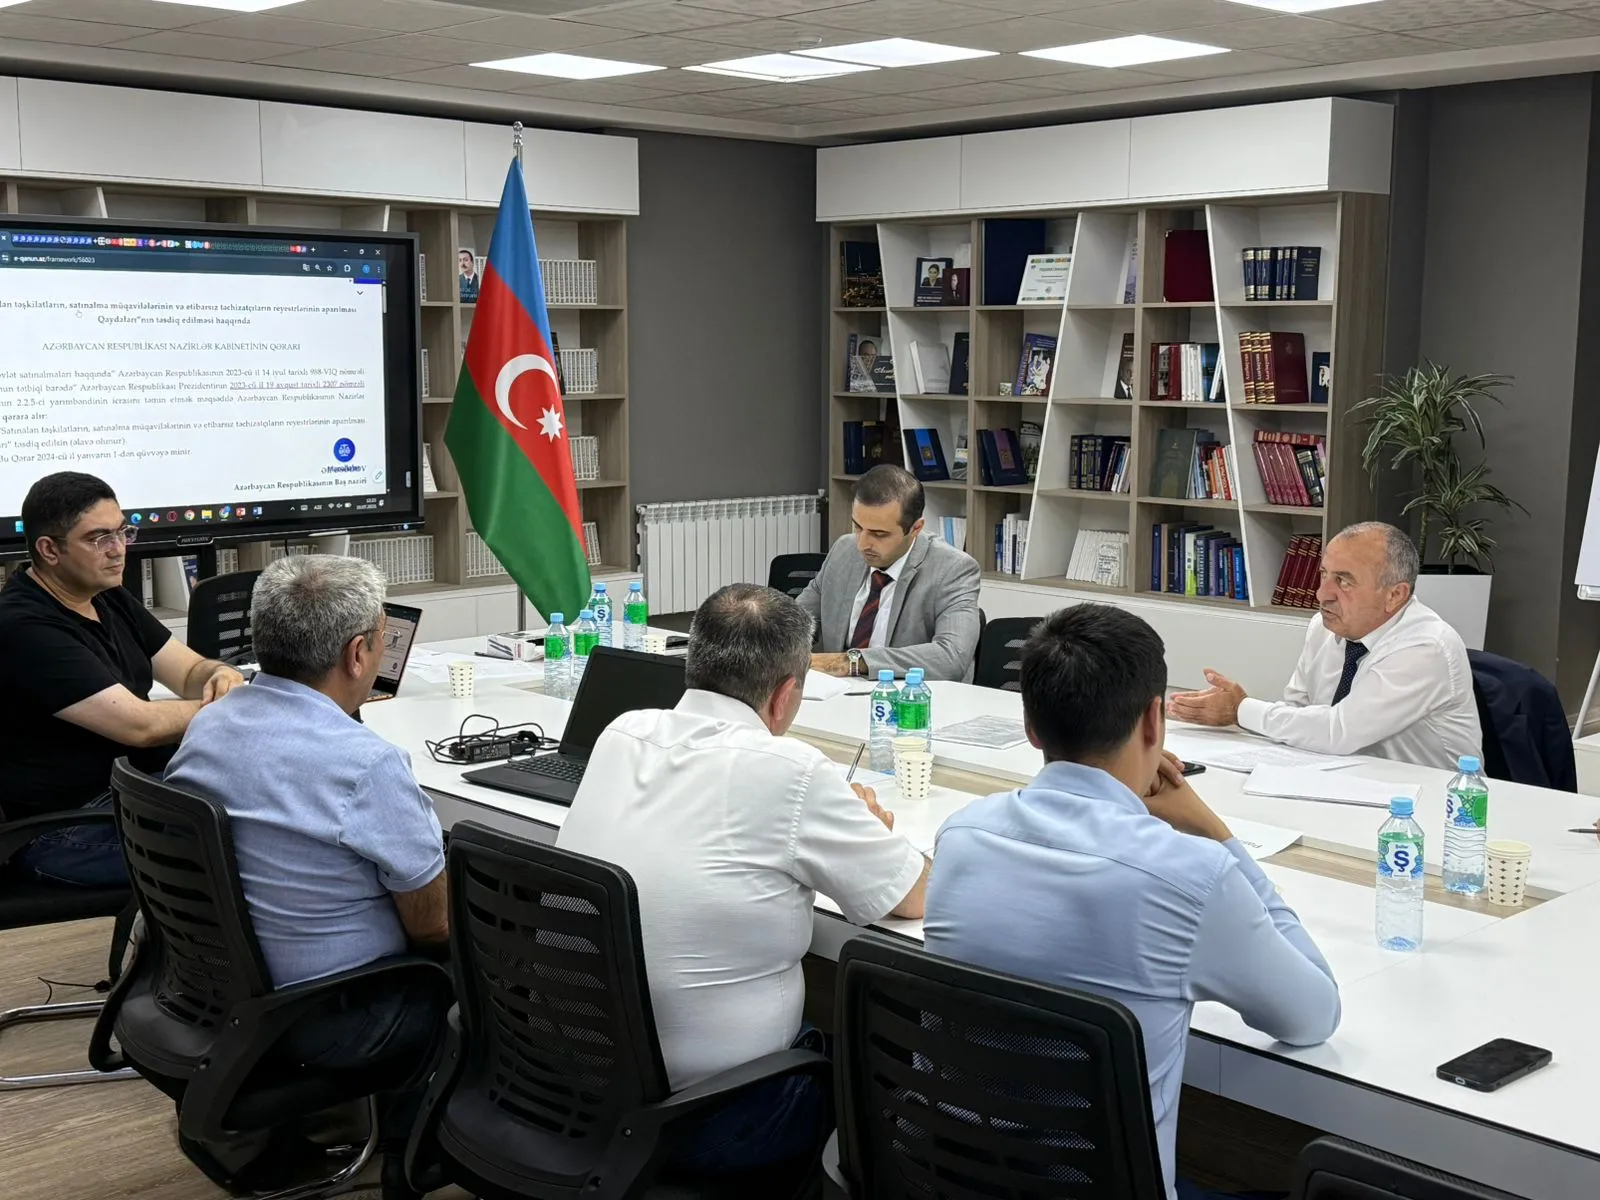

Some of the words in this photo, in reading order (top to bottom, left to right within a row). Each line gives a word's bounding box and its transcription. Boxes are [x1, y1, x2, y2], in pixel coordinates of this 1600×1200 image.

[15, 300, 67, 310] təşkilatların,
[69, 301, 108, 309] satınalma
[110, 302, 173, 312] müqavilələrinin
[187, 303, 218, 311] etibarsız
[220, 303, 271, 313] təchizatçıların
[273, 304, 320, 315] reyestrlərinin
[322, 306, 357, 315] aparılması
[156, 316, 180, 326] təsdiq
[182, 316, 214, 325] edilməsi
[215, 317, 251, 327] haqqında
[42, 342, 105, 351] AZƏRBAYCAN
[107, 341, 167, 351] RESPUBLİKASI
[169, 341, 213, 351] NAZİRLƏR
[214, 341, 268, 351] KABİNETİNİN
[269, 343, 301, 352] QƏRARI
[19, 370, 72, 379] satınalmaları
[118, 369, 163, 380] Azərbaycan
[165, 368, 224, 380] Respublikasının
[255, 368, 260, 376] il
[272, 368, 286, 378] iyul
[16, 384, 43, 395] tətbiqi
[80, 383, 126, 395] Azərbaycan
[128, 382, 176, 393] Respublikası
[179, 381, 228, 391] Prezidentinin
[259, 380, 264, 389] il
[266, 381, 274, 389] 19
[17, 398, 45, 407] 2.2.5-ci
[49, 397, 108, 409] yarımbəndinin
[112, 396, 140, 405] icrasını
[169, 396, 193, 404] etmək
[237, 394, 278, 404] Azərbaycan
[282, 393, 335, 404] Respublikasının
[2, 413, 29, 424] qərara
[93, 422, 130, 433] satınalma
[132, 421, 191, 434] müqavilələrinin
[203, 419, 233, 429] etibarsız
[14, 438, 39, 450] təsdiq
[70, 436, 94, 448] (əlavə
[11, 454, 35, 464] Qərar
[37, 453, 67, 461] 2024-cü
[69, 452, 75, 460] il
[77, 451, 111, 464] yanvarın
[136, 449, 169, 461] qüvvəyə
[234, 482, 276, 493] Azərbaycan
[277, 479, 333, 491] Respublikasının
[334, 478, 346, 487] Baş
[348, 476, 367, 485] naziri
